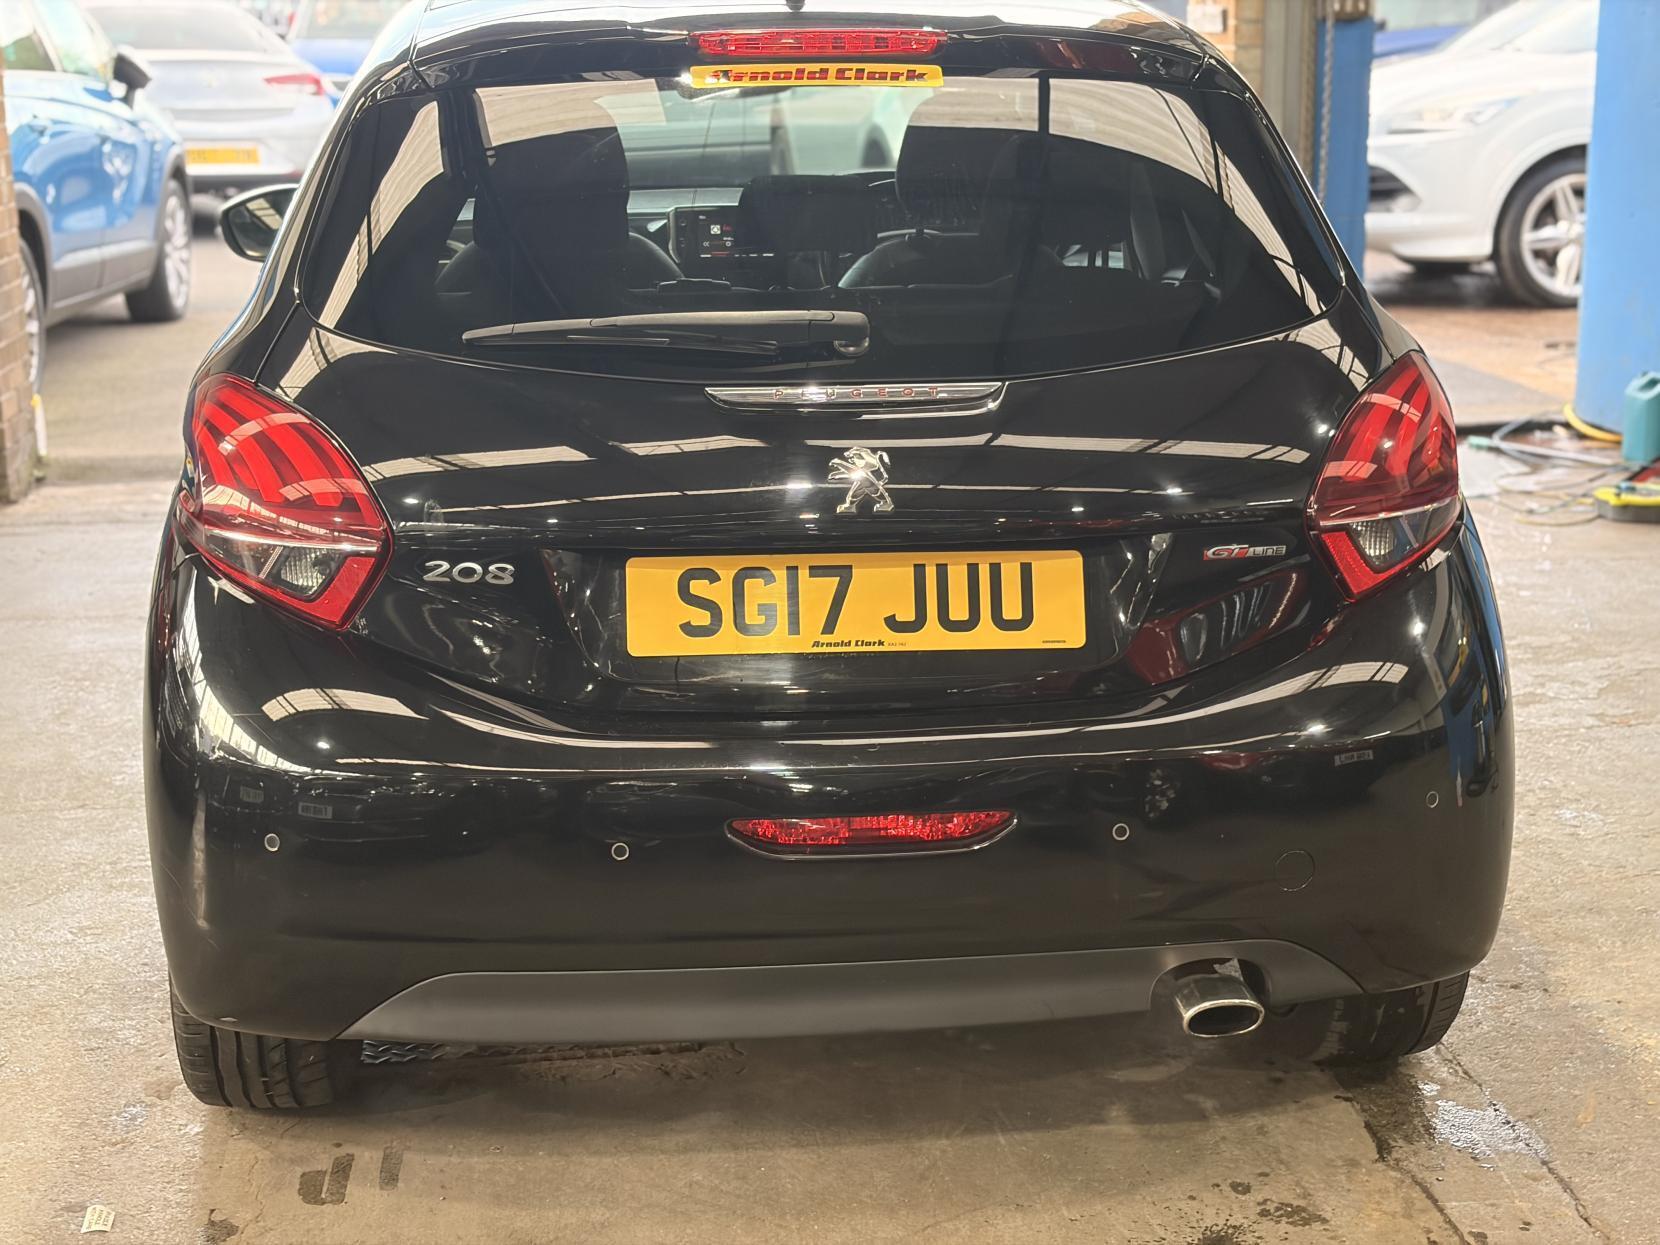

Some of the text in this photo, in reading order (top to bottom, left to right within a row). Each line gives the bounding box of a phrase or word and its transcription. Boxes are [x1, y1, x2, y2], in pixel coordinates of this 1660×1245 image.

[708, 67, 928, 82] Arnold Clark
[1206, 544, 1286, 558] GT LINE
[423, 560, 515, 584] 208
[676, 561, 1035, 638] SG17 JUU
[811, 640, 852, 648] Arnold
[854, 639, 886, 647] Clark
